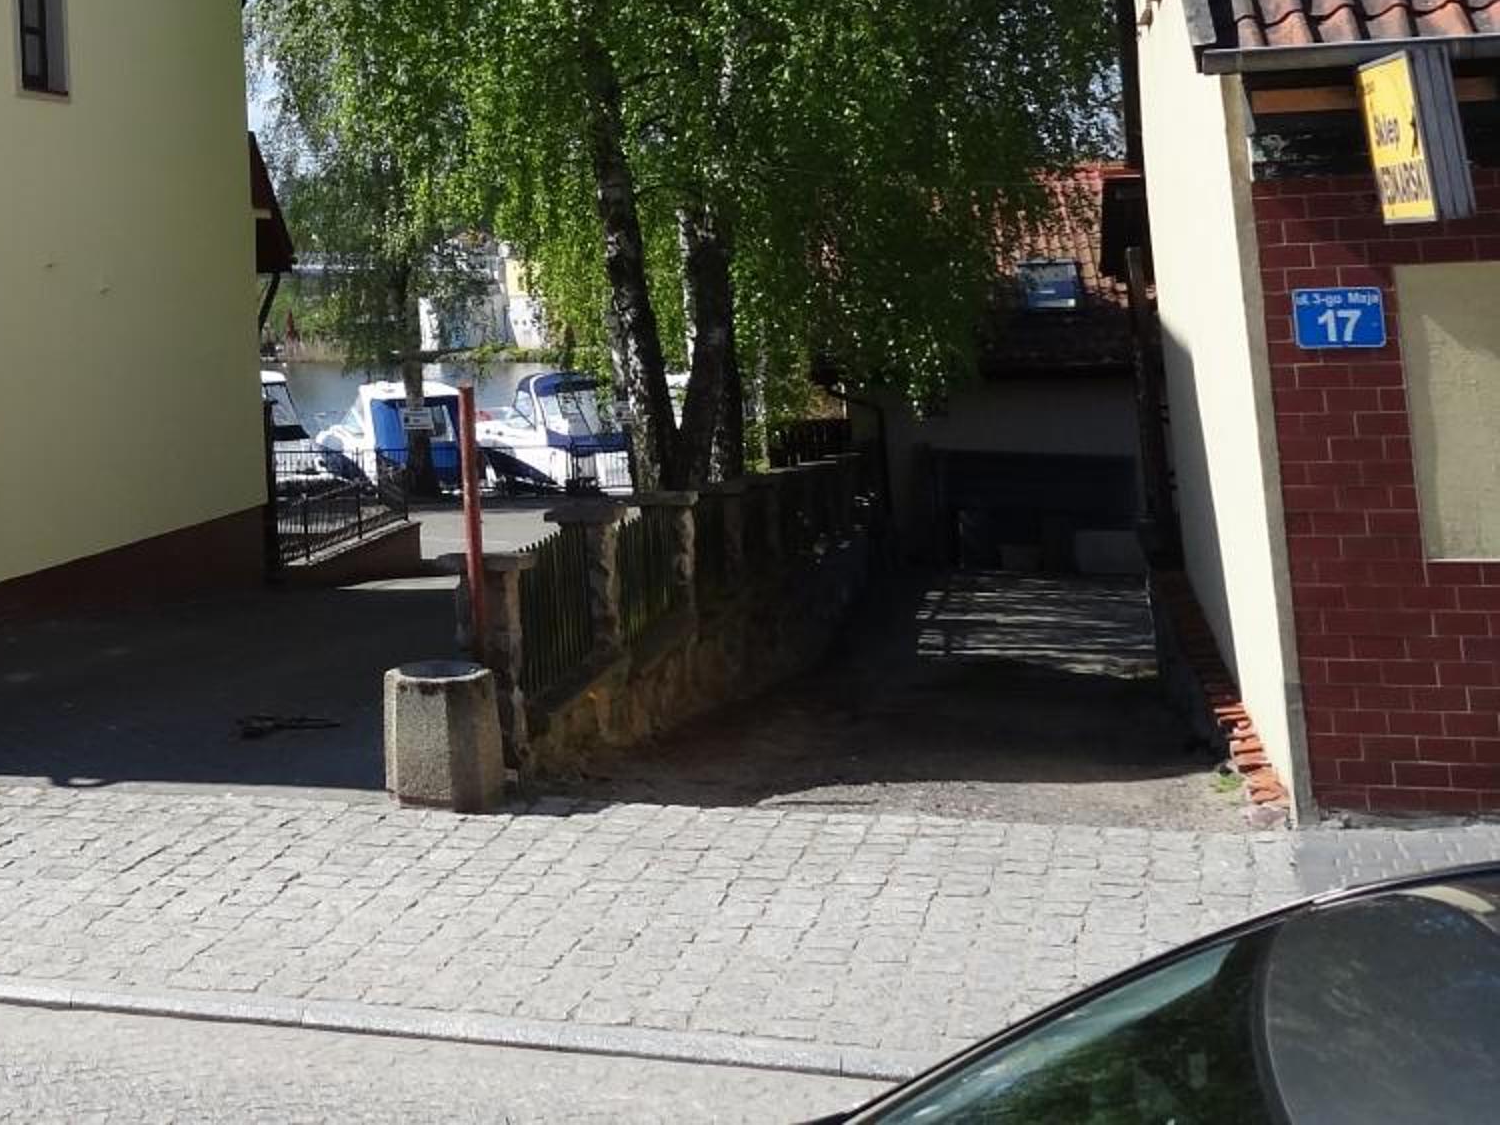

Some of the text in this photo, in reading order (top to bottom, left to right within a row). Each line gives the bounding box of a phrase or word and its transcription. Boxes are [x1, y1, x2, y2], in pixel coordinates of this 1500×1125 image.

[1312, 292, 1343, 307] 3-go
[1347, 291, 1380, 306] Maja
[1317, 309, 1362, 342] 17
